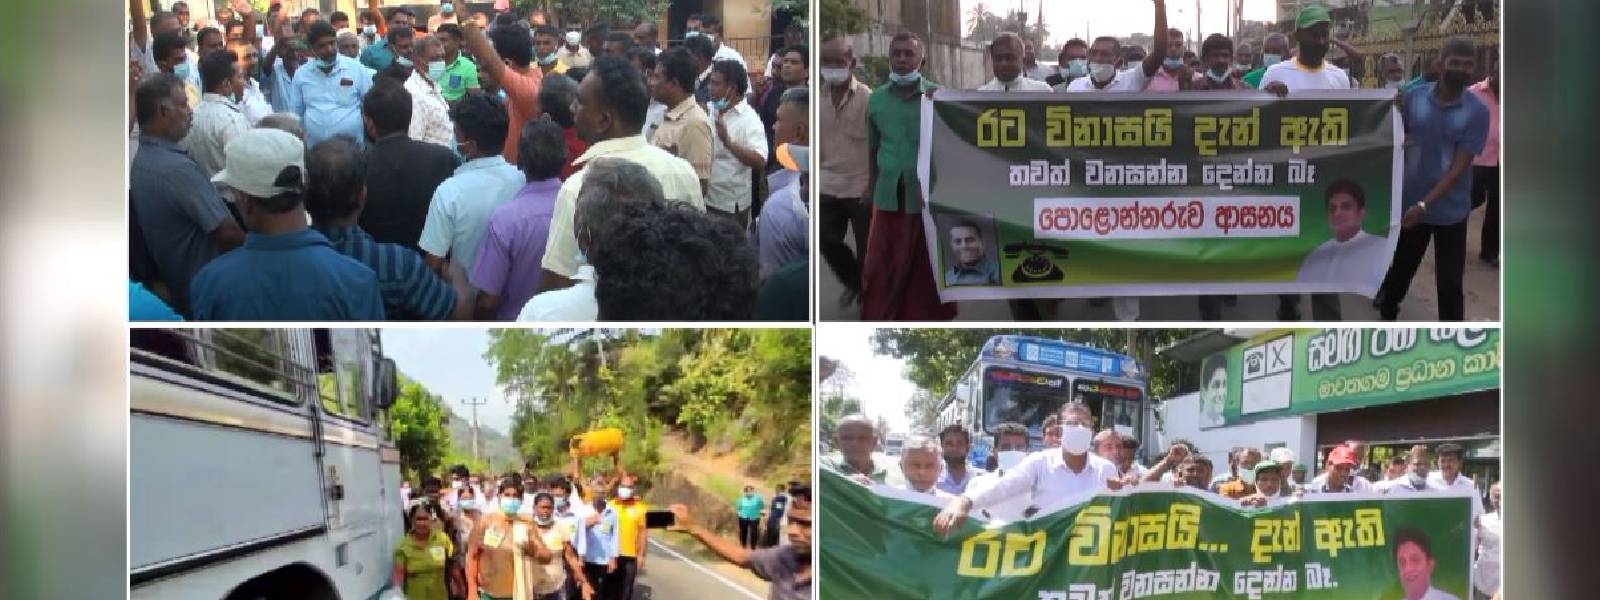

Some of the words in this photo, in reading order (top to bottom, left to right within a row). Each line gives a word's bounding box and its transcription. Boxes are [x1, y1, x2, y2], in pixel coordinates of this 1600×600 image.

[977, 108, 1026, 147] රට
[1046, 105, 1172, 147] විනාසයි
[1194, 107, 1260, 156] දැන්
[1280, 107, 1349, 154] ඇති
[1009, 157, 1071, 186] තවත්
[1085, 157, 1188, 186] වනසන්න
[1202, 157, 1274, 190] දෙන්න
[1288, 158, 1316, 185] බෑ
[1038, 201, 1205, 235] පොළොන්නරුව
[1214, 204, 1295, 234] ආසනය
[957, 528, 1047, 577] රට
[1251, 510, 1301, 563] දැන්
[1313, 508, 1386, 558] ඇති
[1234, 564, 1297, 600] දෙන්න
